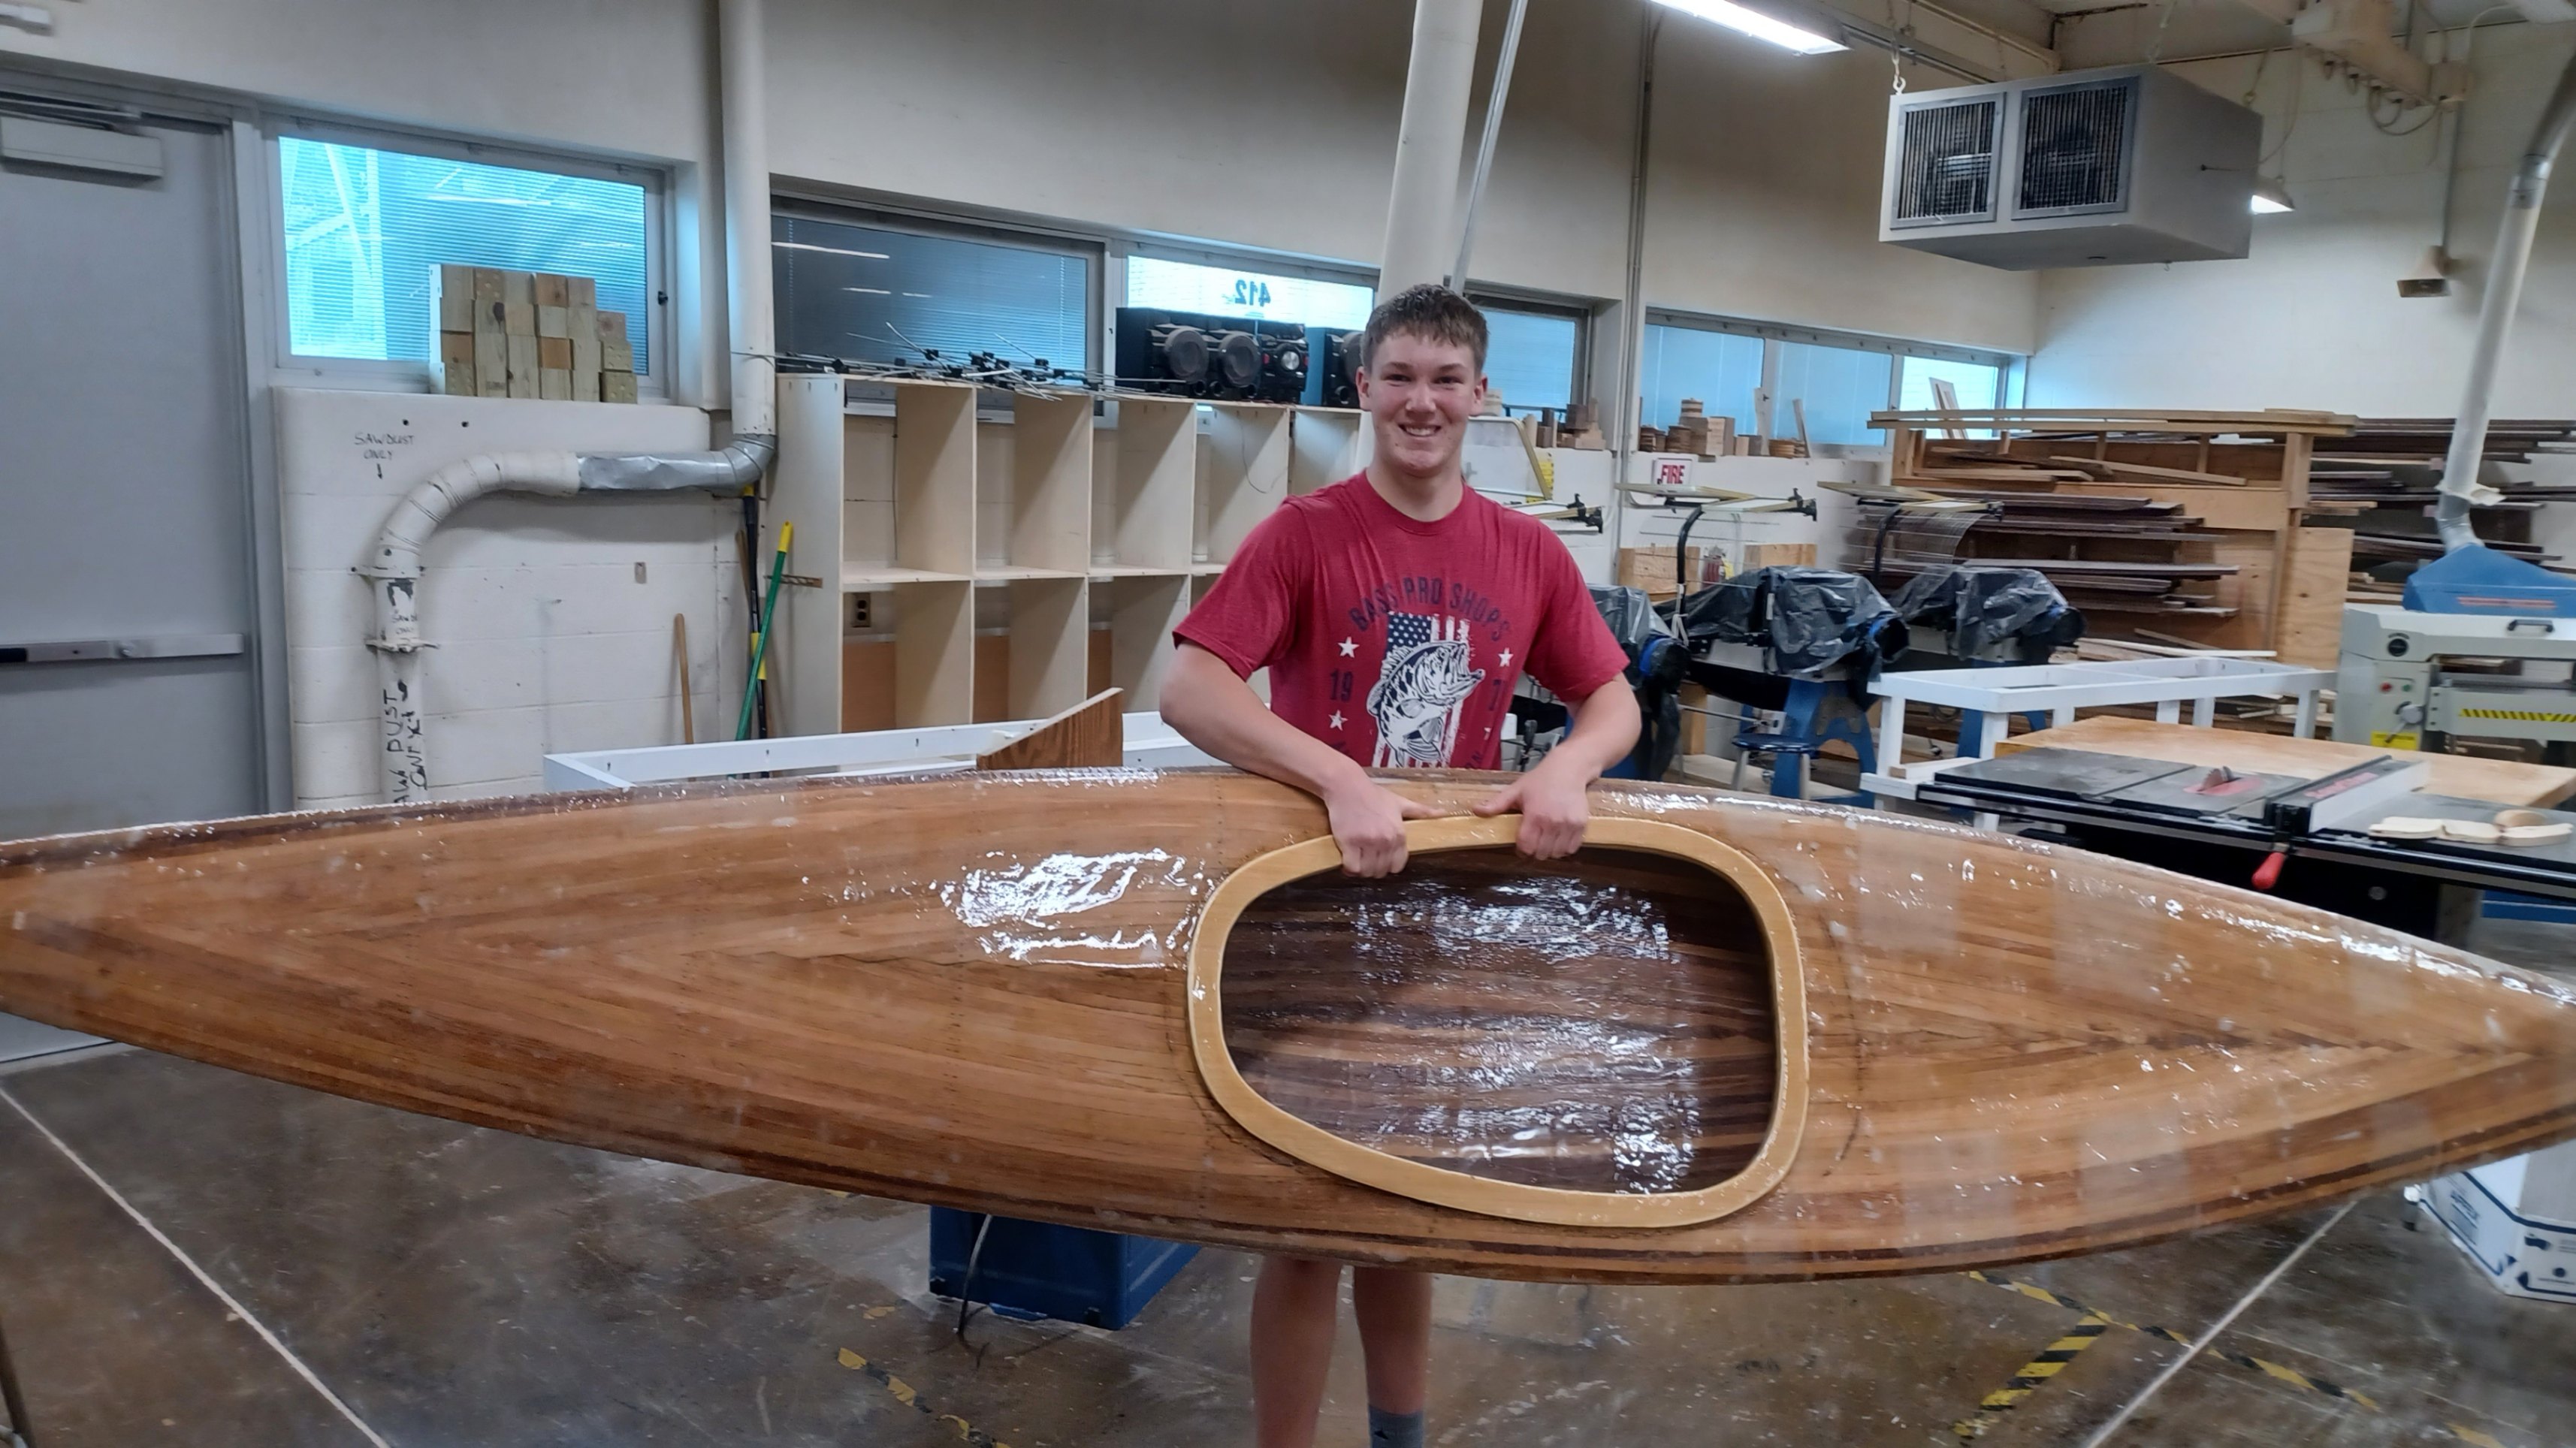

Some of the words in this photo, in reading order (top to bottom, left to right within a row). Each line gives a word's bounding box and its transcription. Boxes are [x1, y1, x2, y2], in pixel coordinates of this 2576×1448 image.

[364, 450, 392, 460] ONLY
[1661, 464, 1685, 484] FIRE
[1348, 582, 1398, 631] BASS
[1403, 576, 1443, 604] PRO
[1449, 583, 1510, 641] SHOPS
[1330, 668, 1353, 702] 19
[383, 689, 404, 752] DUST
